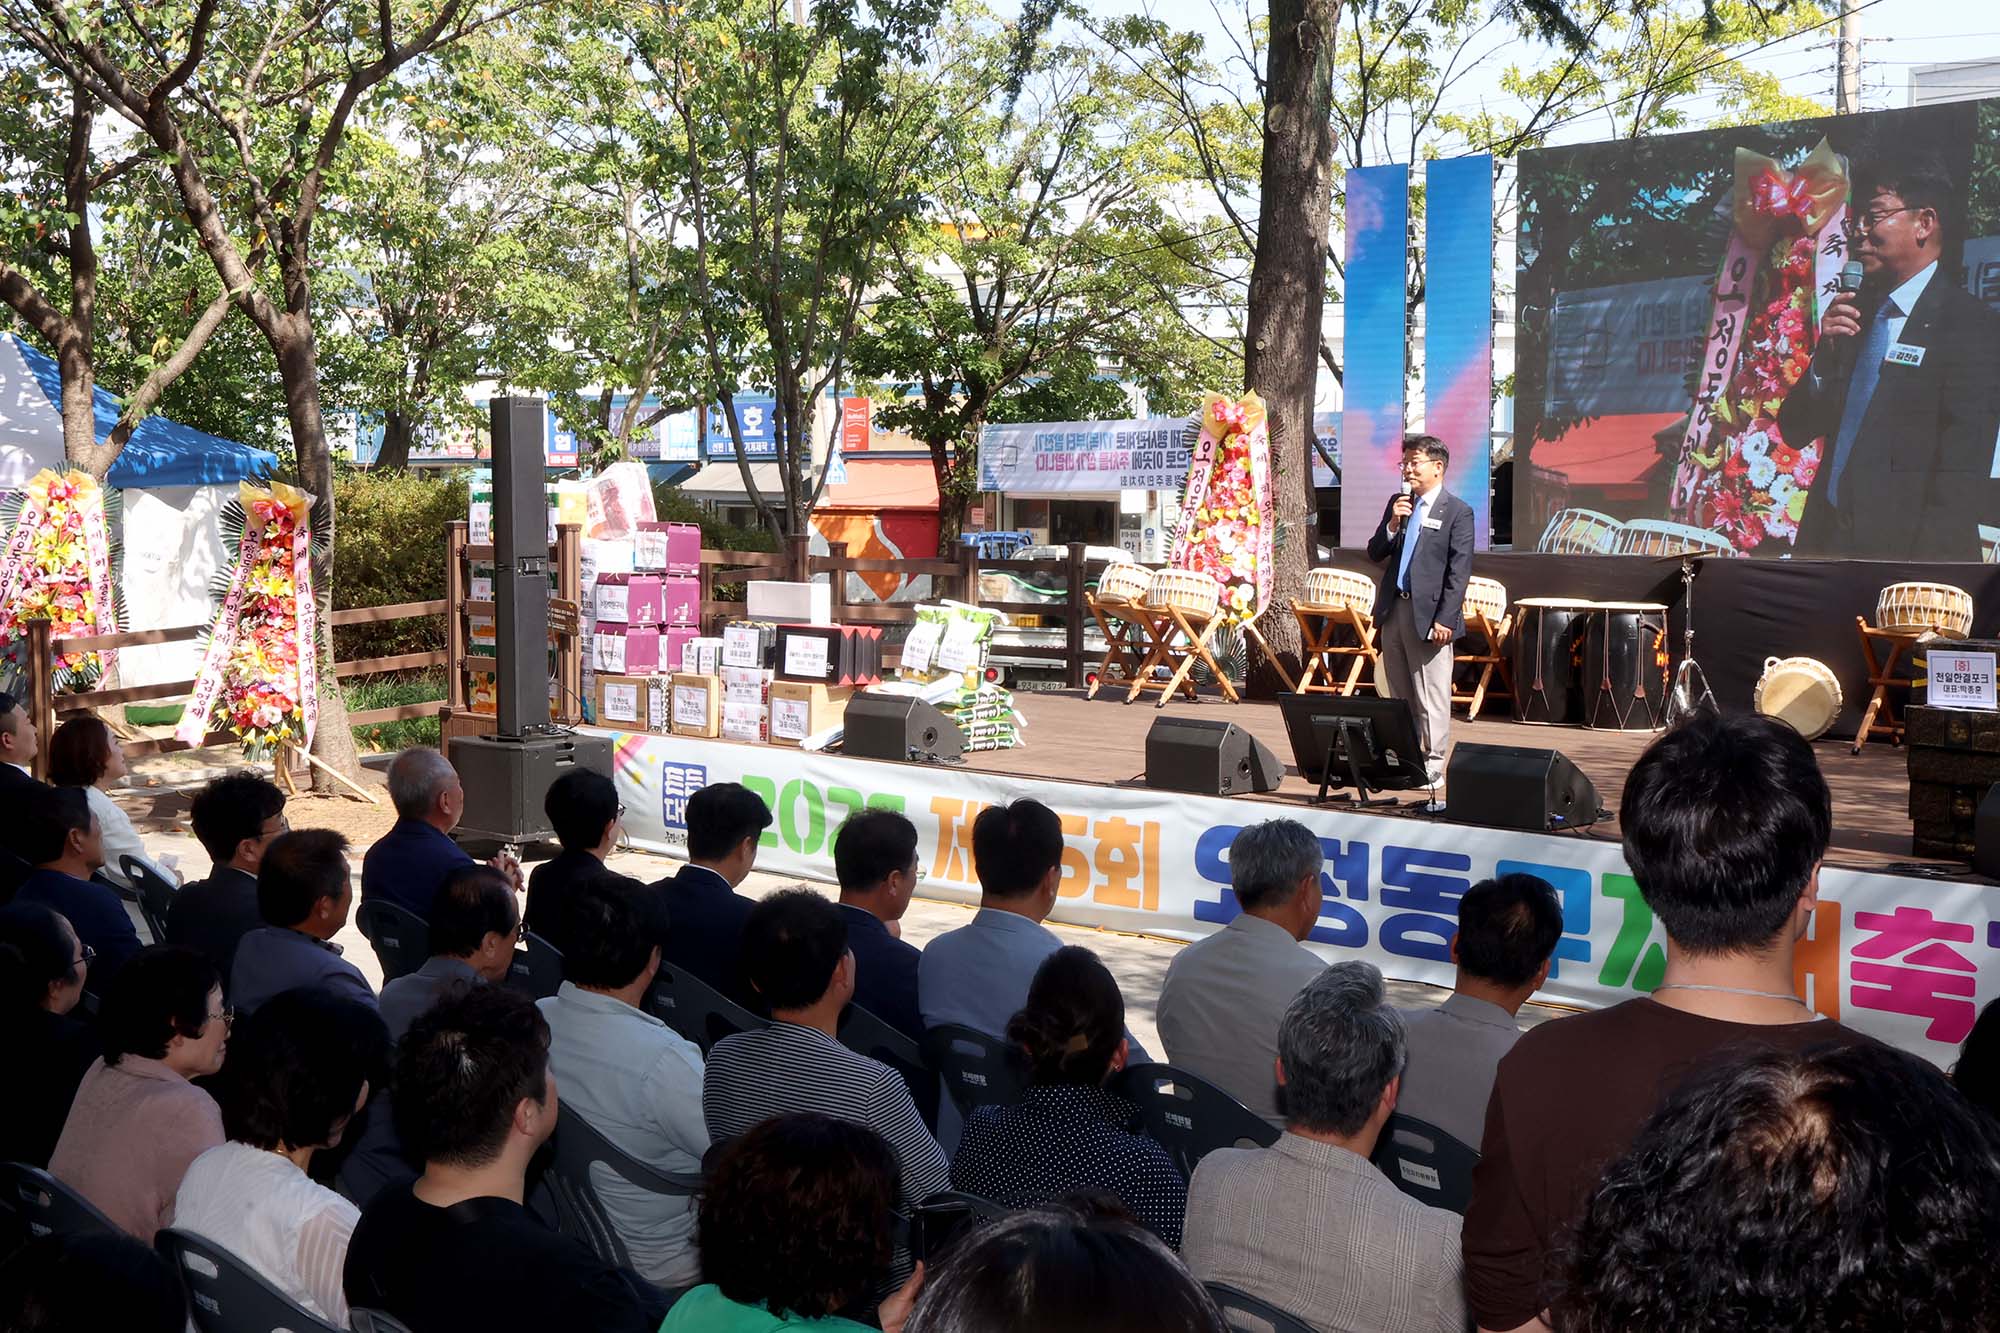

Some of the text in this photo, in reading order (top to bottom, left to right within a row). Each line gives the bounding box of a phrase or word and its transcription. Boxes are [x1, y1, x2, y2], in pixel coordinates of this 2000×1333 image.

[300, 603, 315, 646] 오정동
[301, 651, 317, 722] 무지개축제
[929, 796, 1161, 912] 제5회
[1496, 860, 2000, 1045] 무지축
